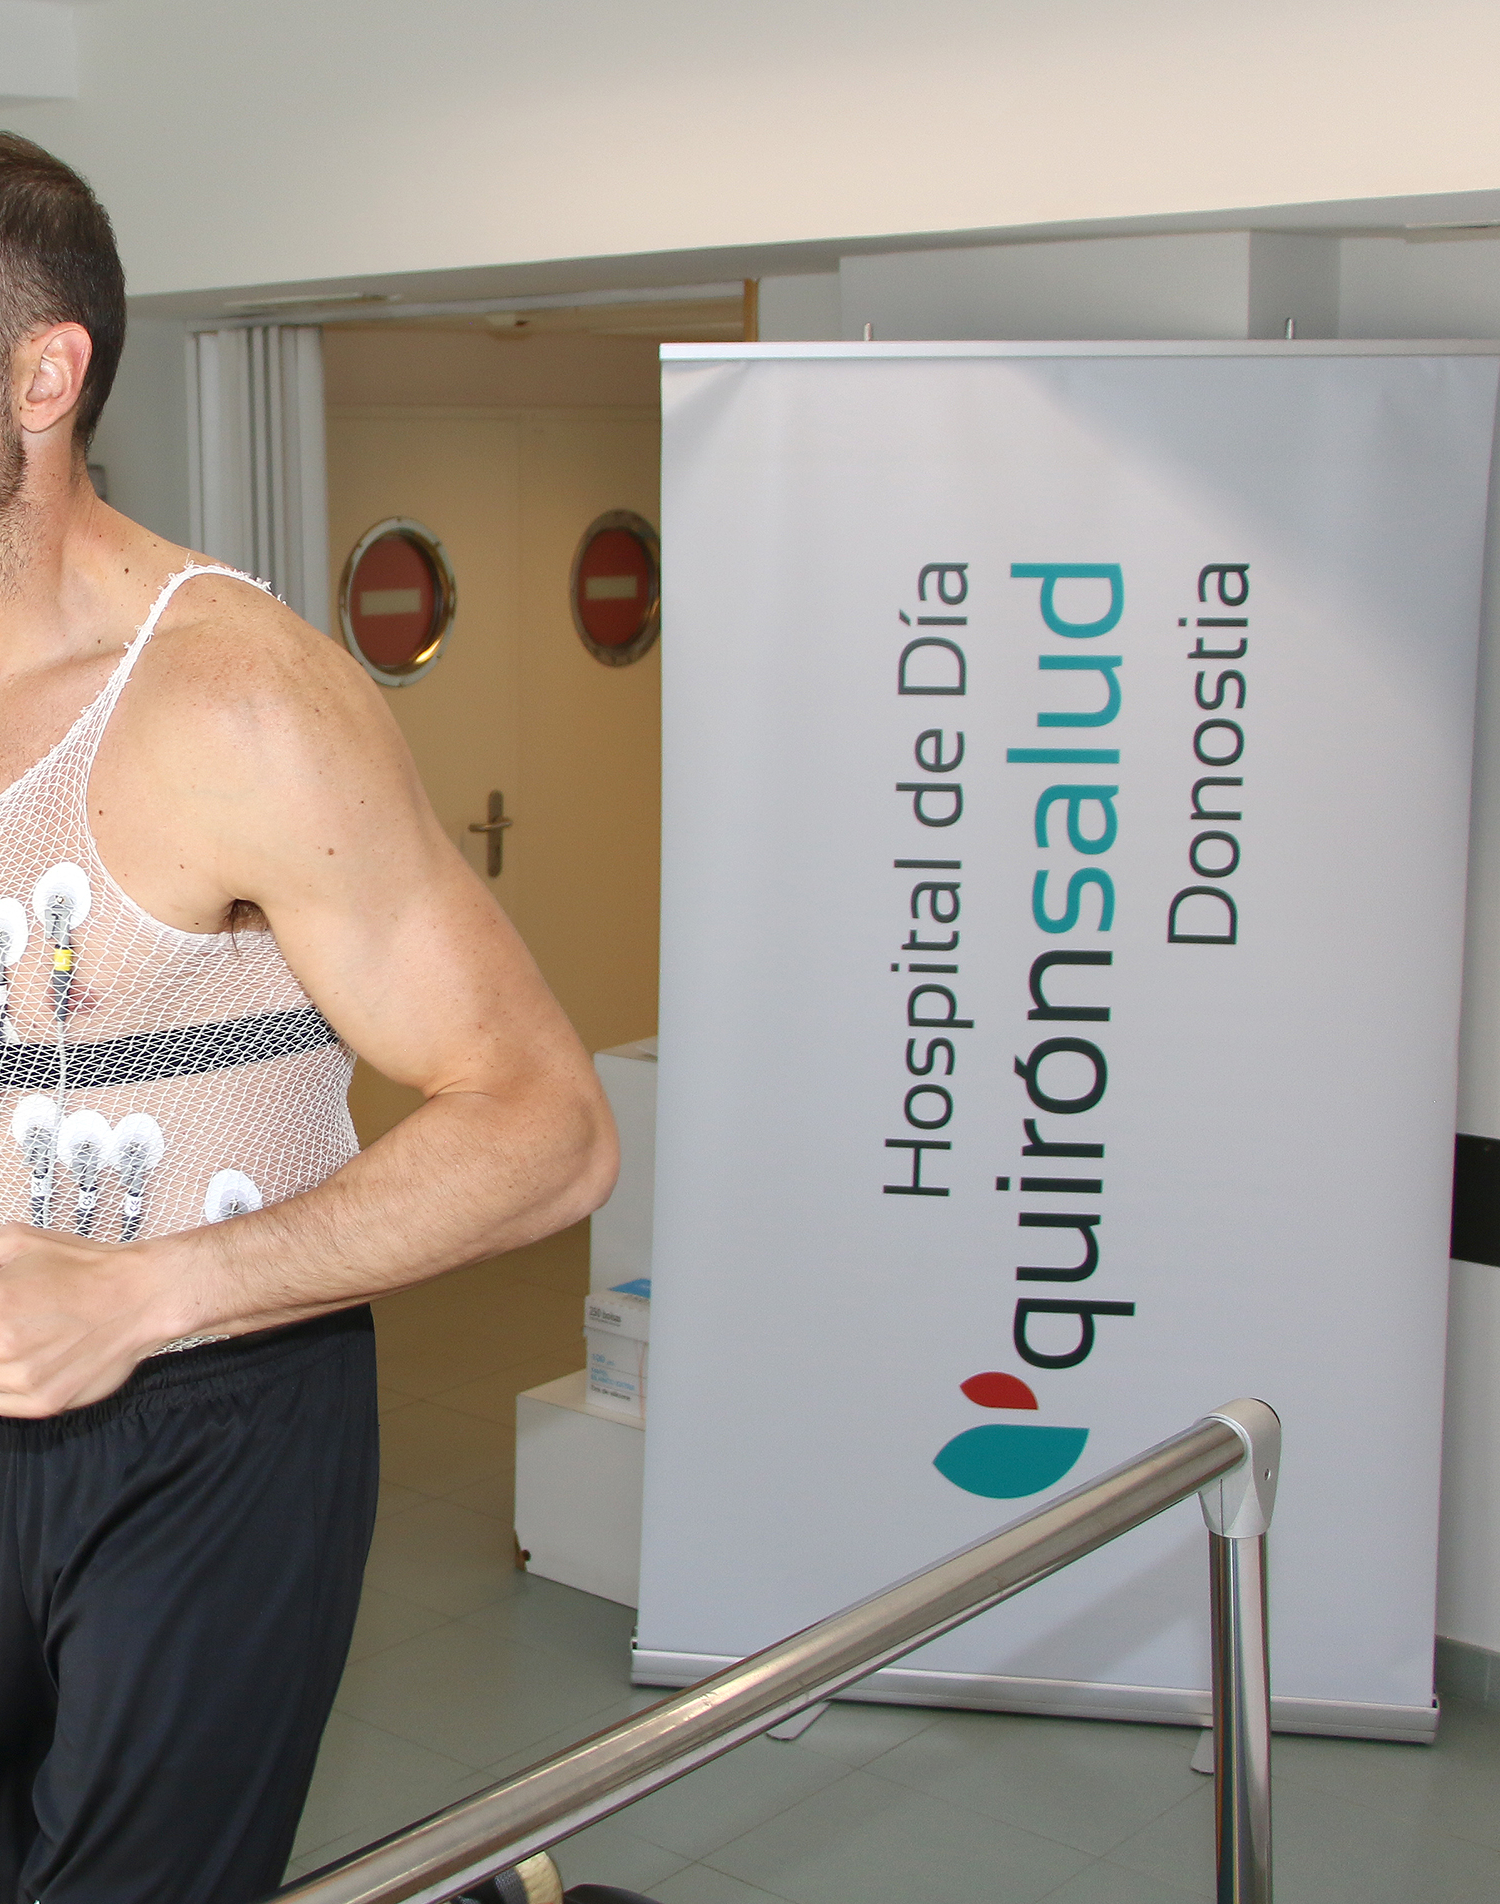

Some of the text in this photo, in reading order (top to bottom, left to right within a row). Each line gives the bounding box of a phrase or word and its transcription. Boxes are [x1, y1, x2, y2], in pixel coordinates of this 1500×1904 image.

[883, 562, 975, 1197] Hospital de Día
[995, 563, 1137, 1370] quirónsalud
[1168, 563, 1251, 946] Donostia
